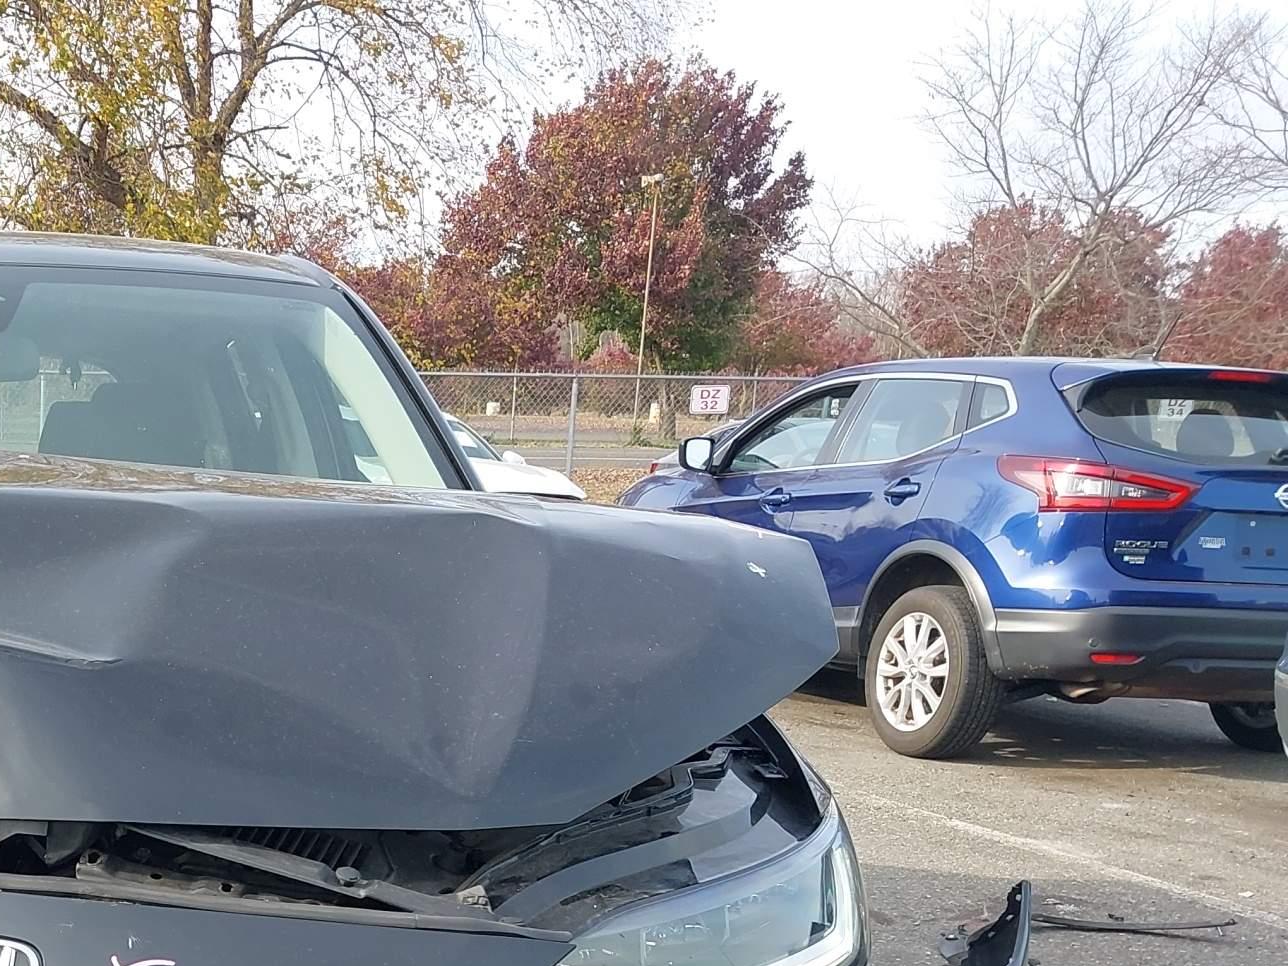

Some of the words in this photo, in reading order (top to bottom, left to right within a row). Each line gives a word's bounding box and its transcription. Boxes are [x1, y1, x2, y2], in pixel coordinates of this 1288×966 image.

[700, 389, 721, 399] DZ
[700, 400, 718, 410] 32
[1167, 407, 1184, 417] 34
[1114, 540, 1169, 549] ROGUE
